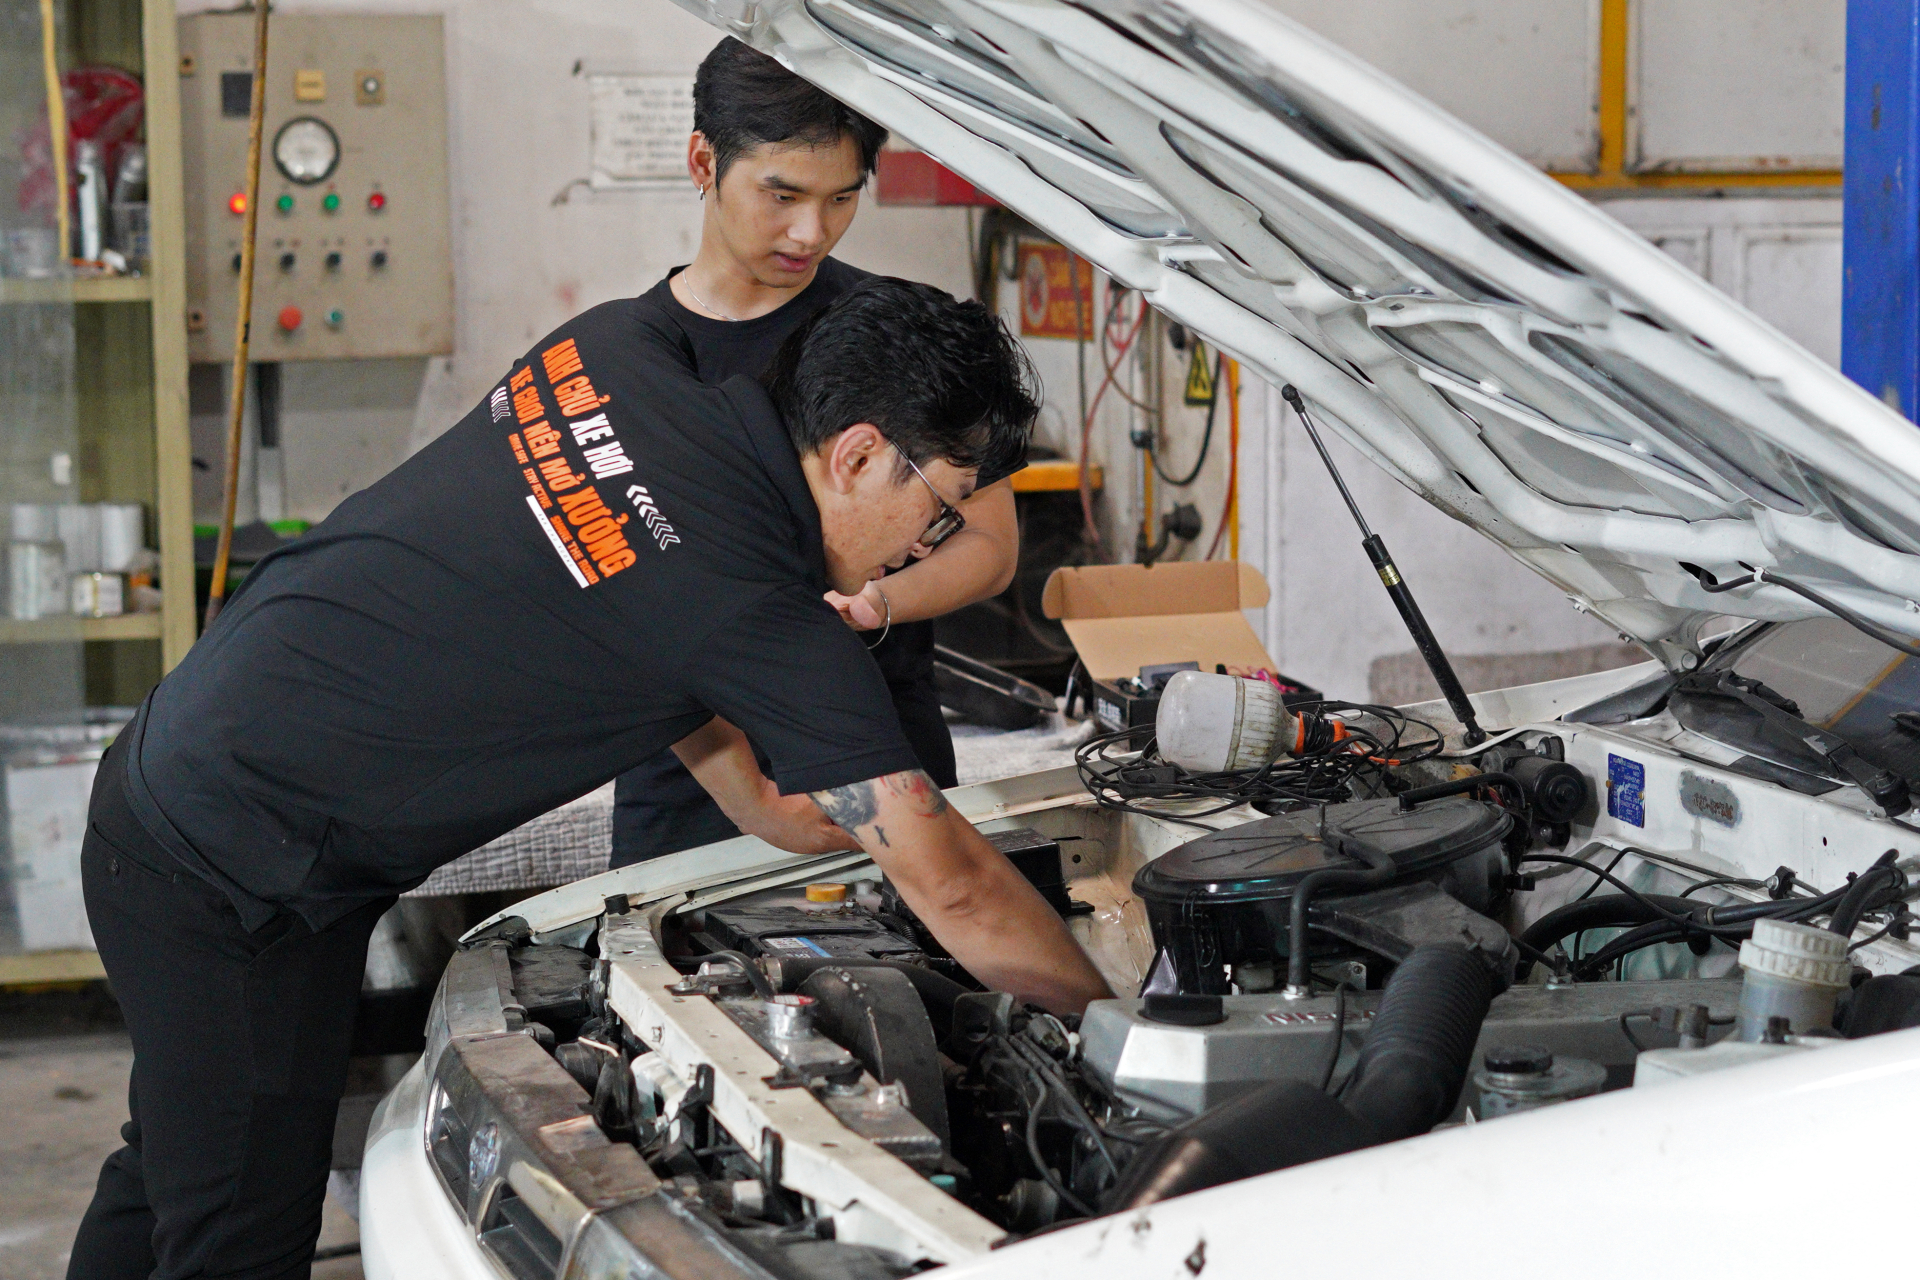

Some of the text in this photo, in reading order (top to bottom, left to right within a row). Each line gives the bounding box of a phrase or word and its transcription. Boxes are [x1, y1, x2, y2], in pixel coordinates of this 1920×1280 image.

[542, 338, 634, 480] ANH CHỦ XE HƠI
[510, 365, 637, 578] XE CHƠI NÊN MỞ XƯỞNG
[523, 468, 553, 509] STAY ACTIVE
[550, 515, 600, 585] SHARE THE ROAD
